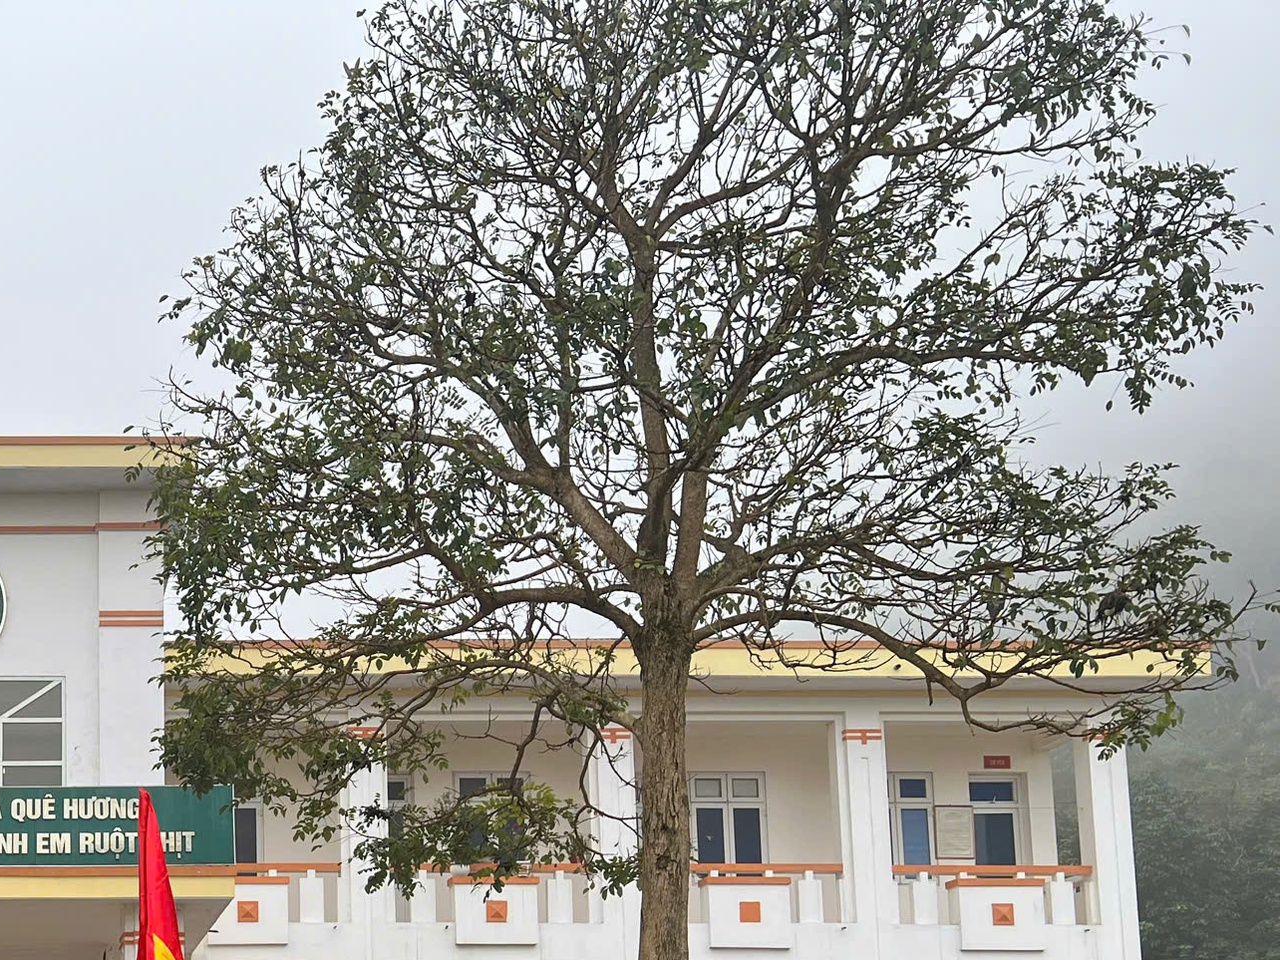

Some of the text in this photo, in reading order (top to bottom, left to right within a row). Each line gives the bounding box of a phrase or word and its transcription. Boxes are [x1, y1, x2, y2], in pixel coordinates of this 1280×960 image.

[10, 793, 56, 823] QUÊ
[63, 795, 139, 820] HƯƠNG
[36, 831, 72, 854] EM
[79, 827, 138, 859] RUỘT
[160, 831, 196, 859] HỊT
